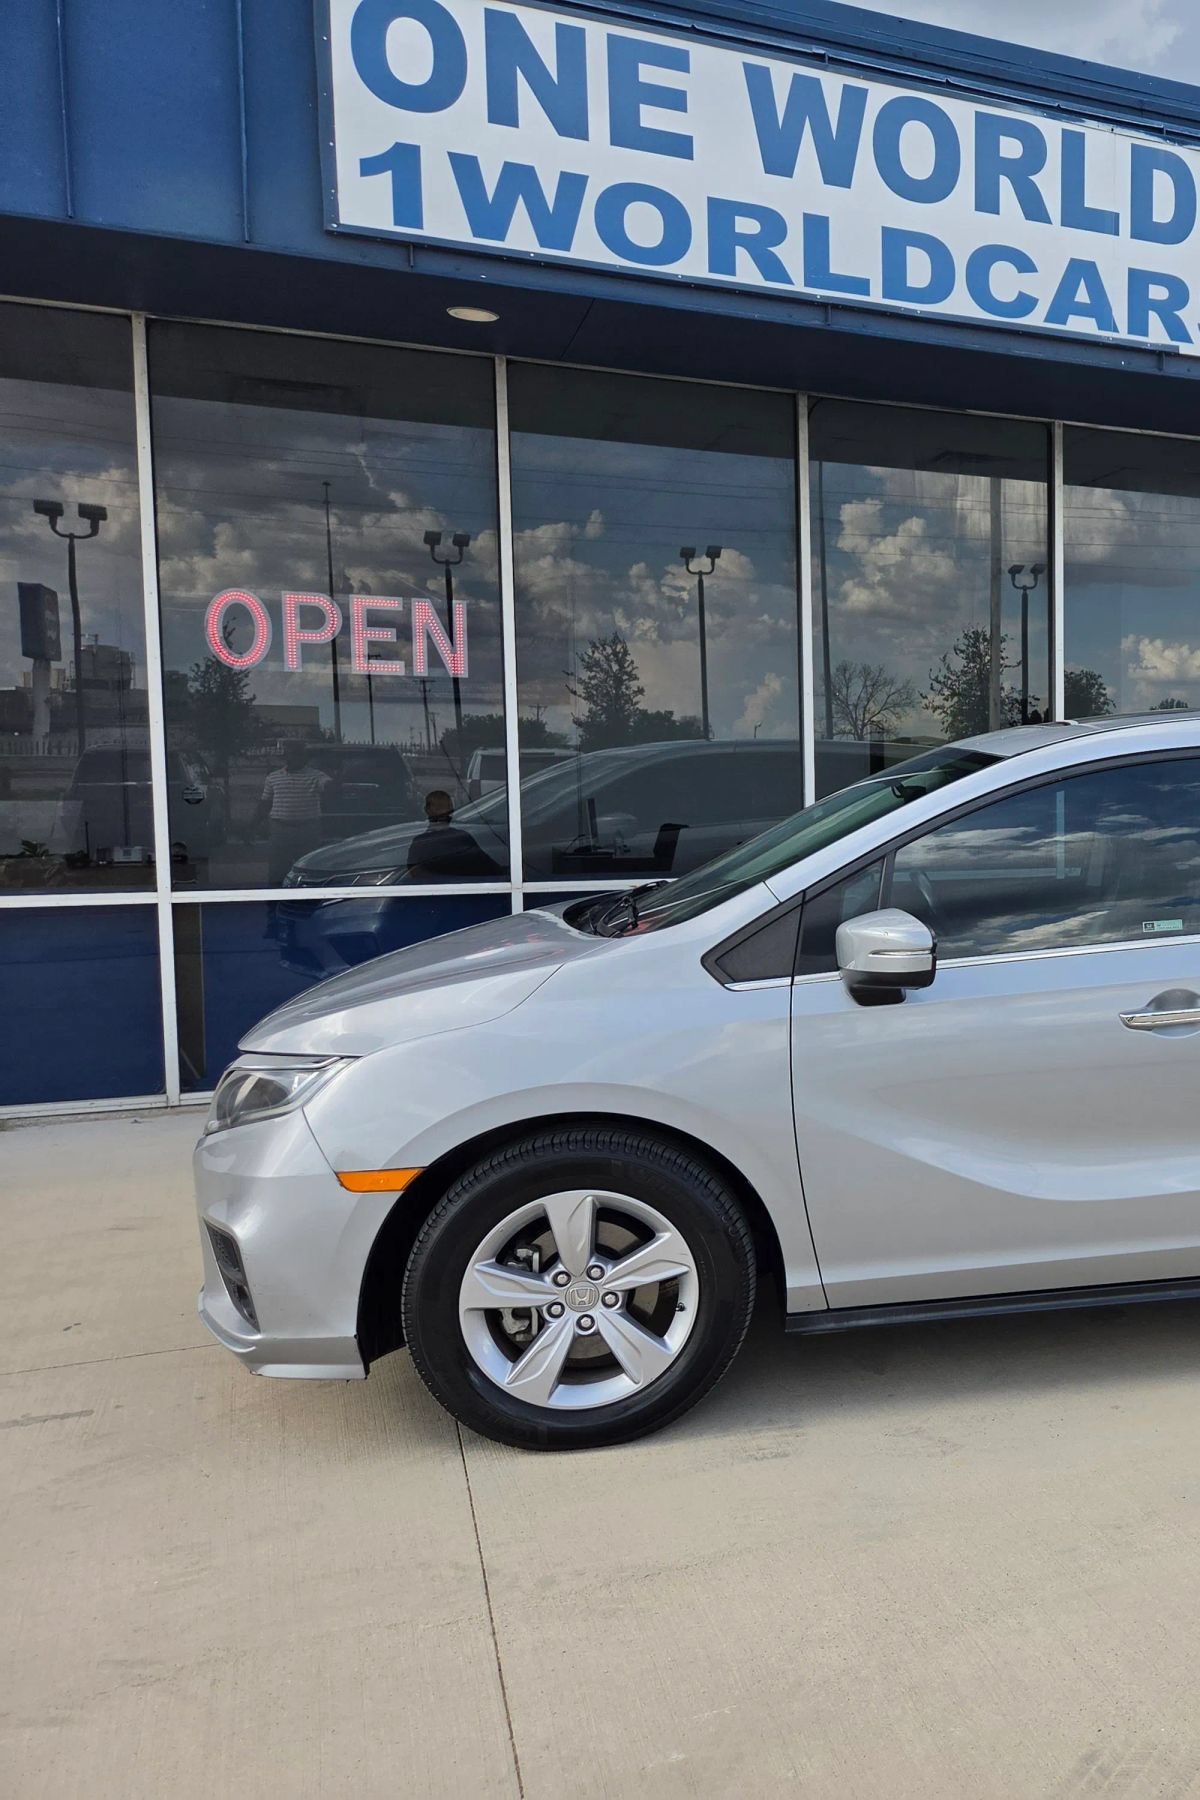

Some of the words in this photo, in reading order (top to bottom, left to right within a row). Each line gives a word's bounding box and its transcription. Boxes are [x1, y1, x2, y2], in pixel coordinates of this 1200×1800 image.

[350, 0, 694, 161] ONE
[742, 61, 1197, 246] WORLD
[204, 587, 470, 678] OPEN
